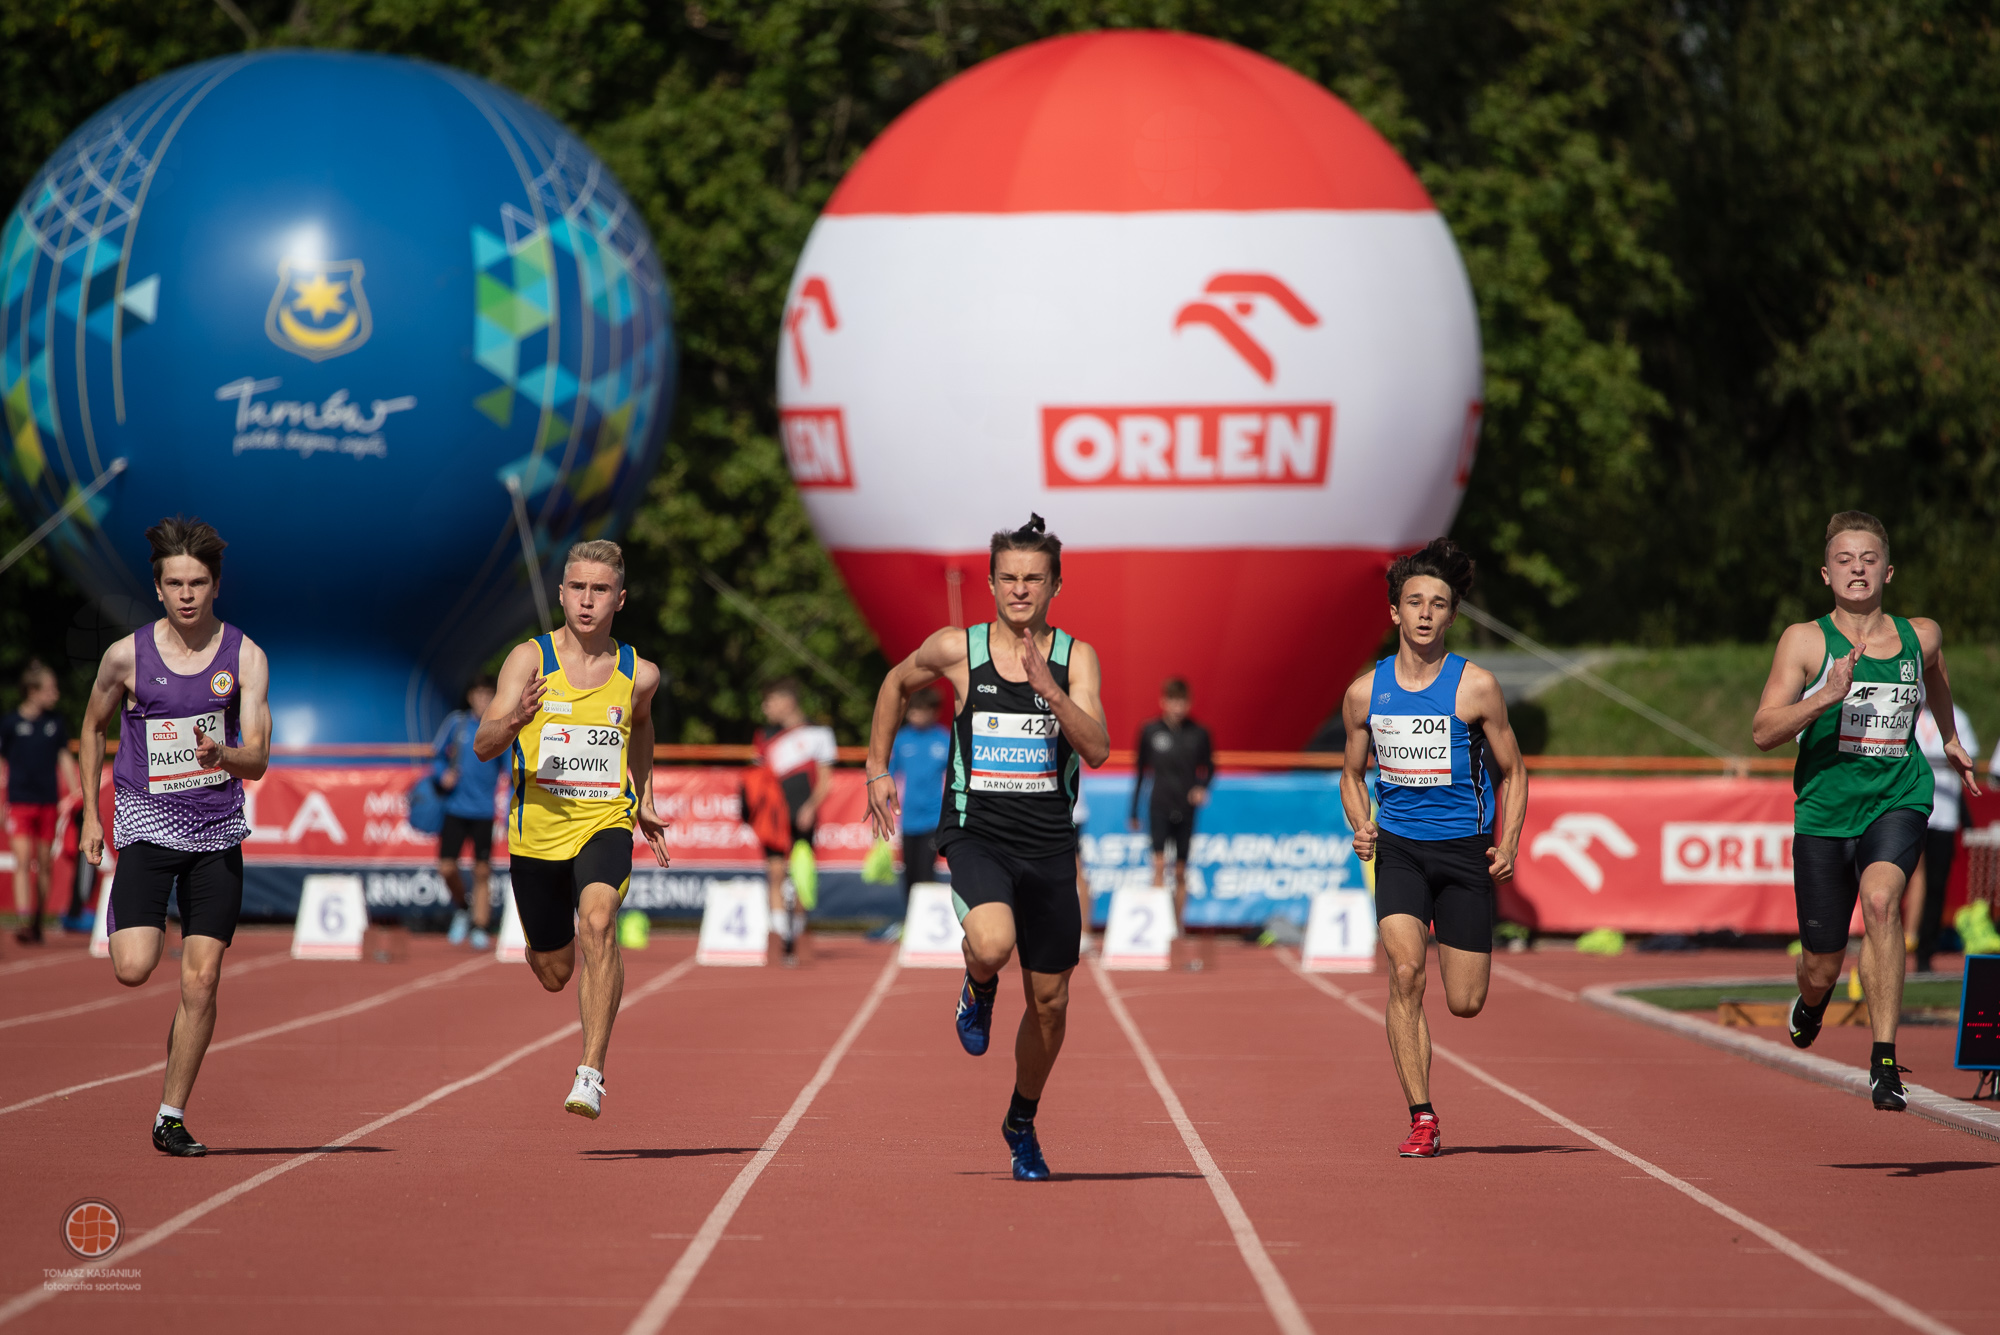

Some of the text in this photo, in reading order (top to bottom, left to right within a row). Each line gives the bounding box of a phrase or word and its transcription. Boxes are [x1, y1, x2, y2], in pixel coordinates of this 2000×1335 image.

[1052, 412, 1322, 482] ORLEN
[977, 684, 998, 694] esa
[1891, 687, 1919, 704] 143
[196, 715, 217, 734] 82
[1021, 718, 1057, 735] 427
[1412, 718, 1447, 735] 204
[1850, 713, 1909, 729] PIETRZAK
[587, 729, 620, 746] 328
[973, 745, 1056, 764] ZAKRZEWSKI
[1378, 745, 1447, 760] RUTOWICZ
[1853, 744, 1904, 755] TARNÓW 2019
[552, 756, 609, 772] SŁOWIK
[163, 778, 201, 791] TARNÓW
[203, 773, 222, 785] 2019
[983, 780, 1046, 790] TARNÓW 2019
[1388, 774, 1438, 785] TARNÓW 2019
[549, 787, 608, 798] TARNÓW 2019
[319, 896, 345, 935] 6
[723, 903, 748, 939] 4
[926, 902, 952, 944] 3
[1130, 905, 1155, 947] 2
[1334, 909, 1350, 947] 1
